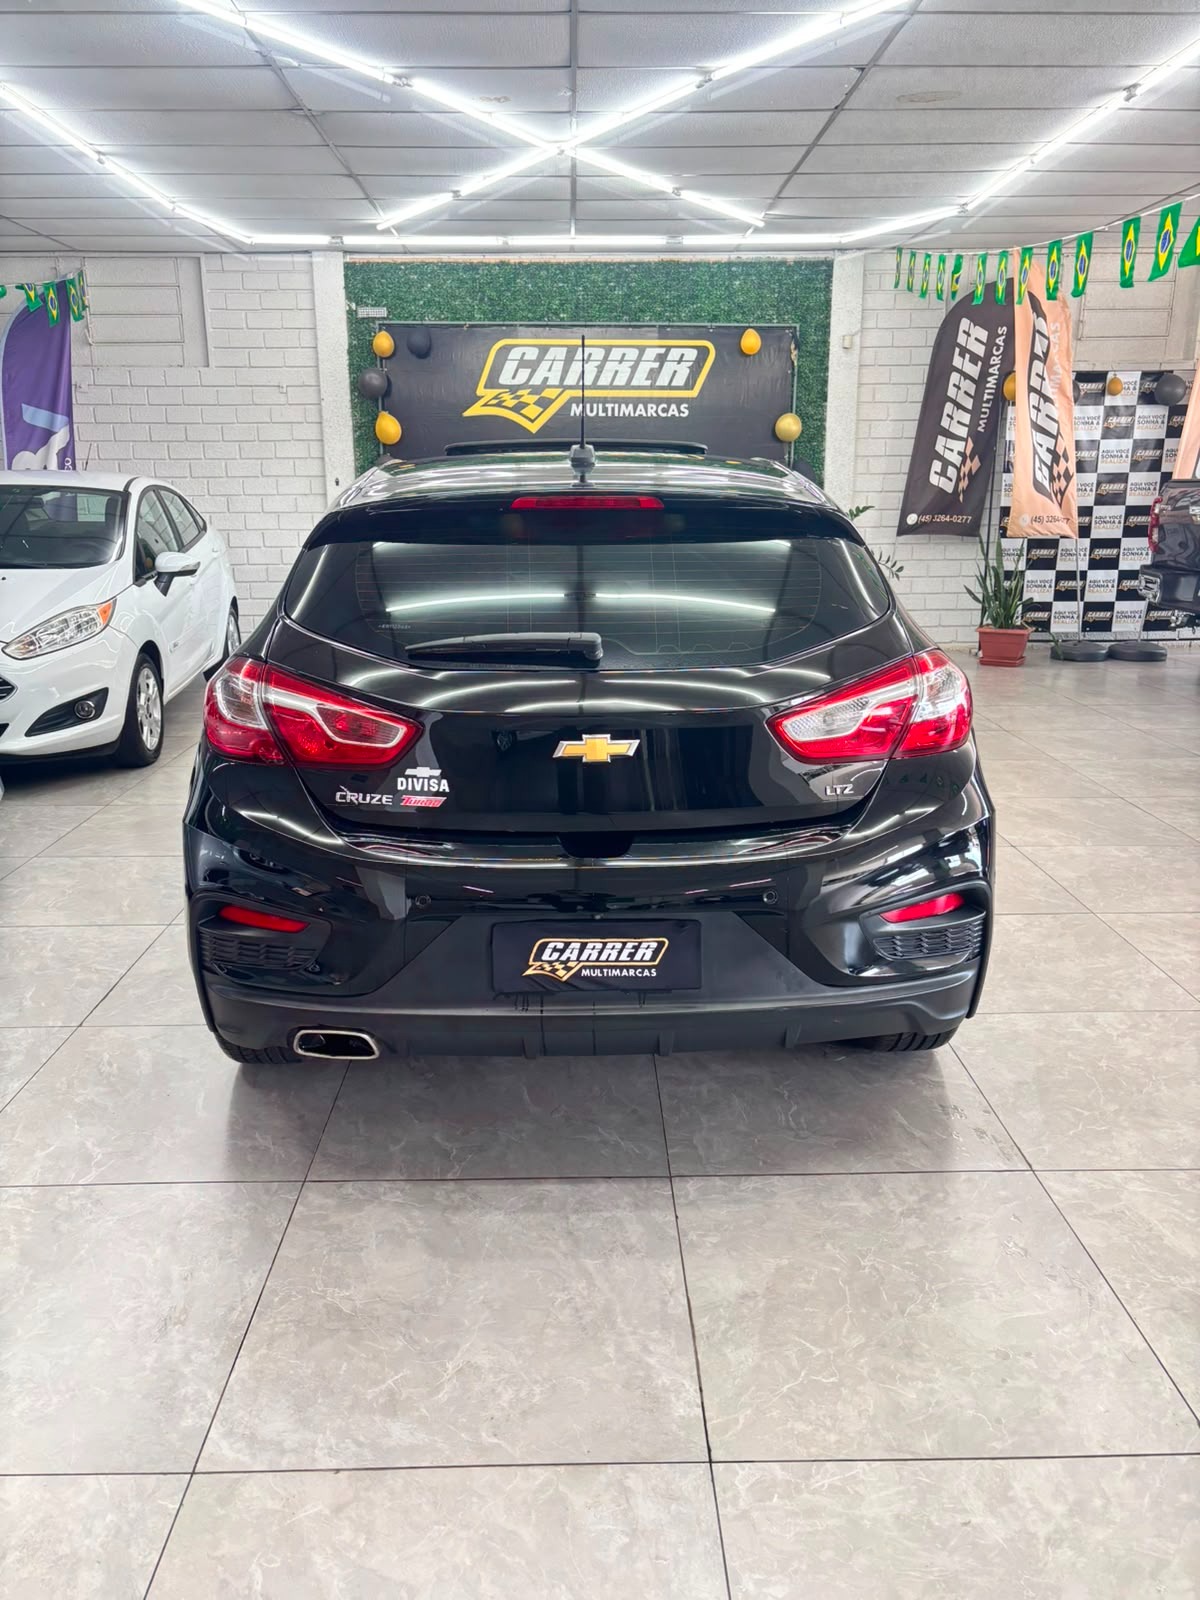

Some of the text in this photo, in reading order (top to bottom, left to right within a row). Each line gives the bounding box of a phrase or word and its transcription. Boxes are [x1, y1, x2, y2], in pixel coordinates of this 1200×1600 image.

[499, 346, 697, 387] CARRER
[978, 326, 1007, 433] MULTIMARCAS
[570, 403, 689, 418] MULTIMARCAS
[929, 318, 989, 494] CARRER
[918, 514, 972, 525] (45) 3264-0277
[397, 778, 449, 792] DIVISA
[825, 784, 854, 796] LTZ
[335, 792, 393, 805] CRUZE
[541, 942, 657, 961] CARRER
[581, 969, 657, 977] MULTIMARCAS
